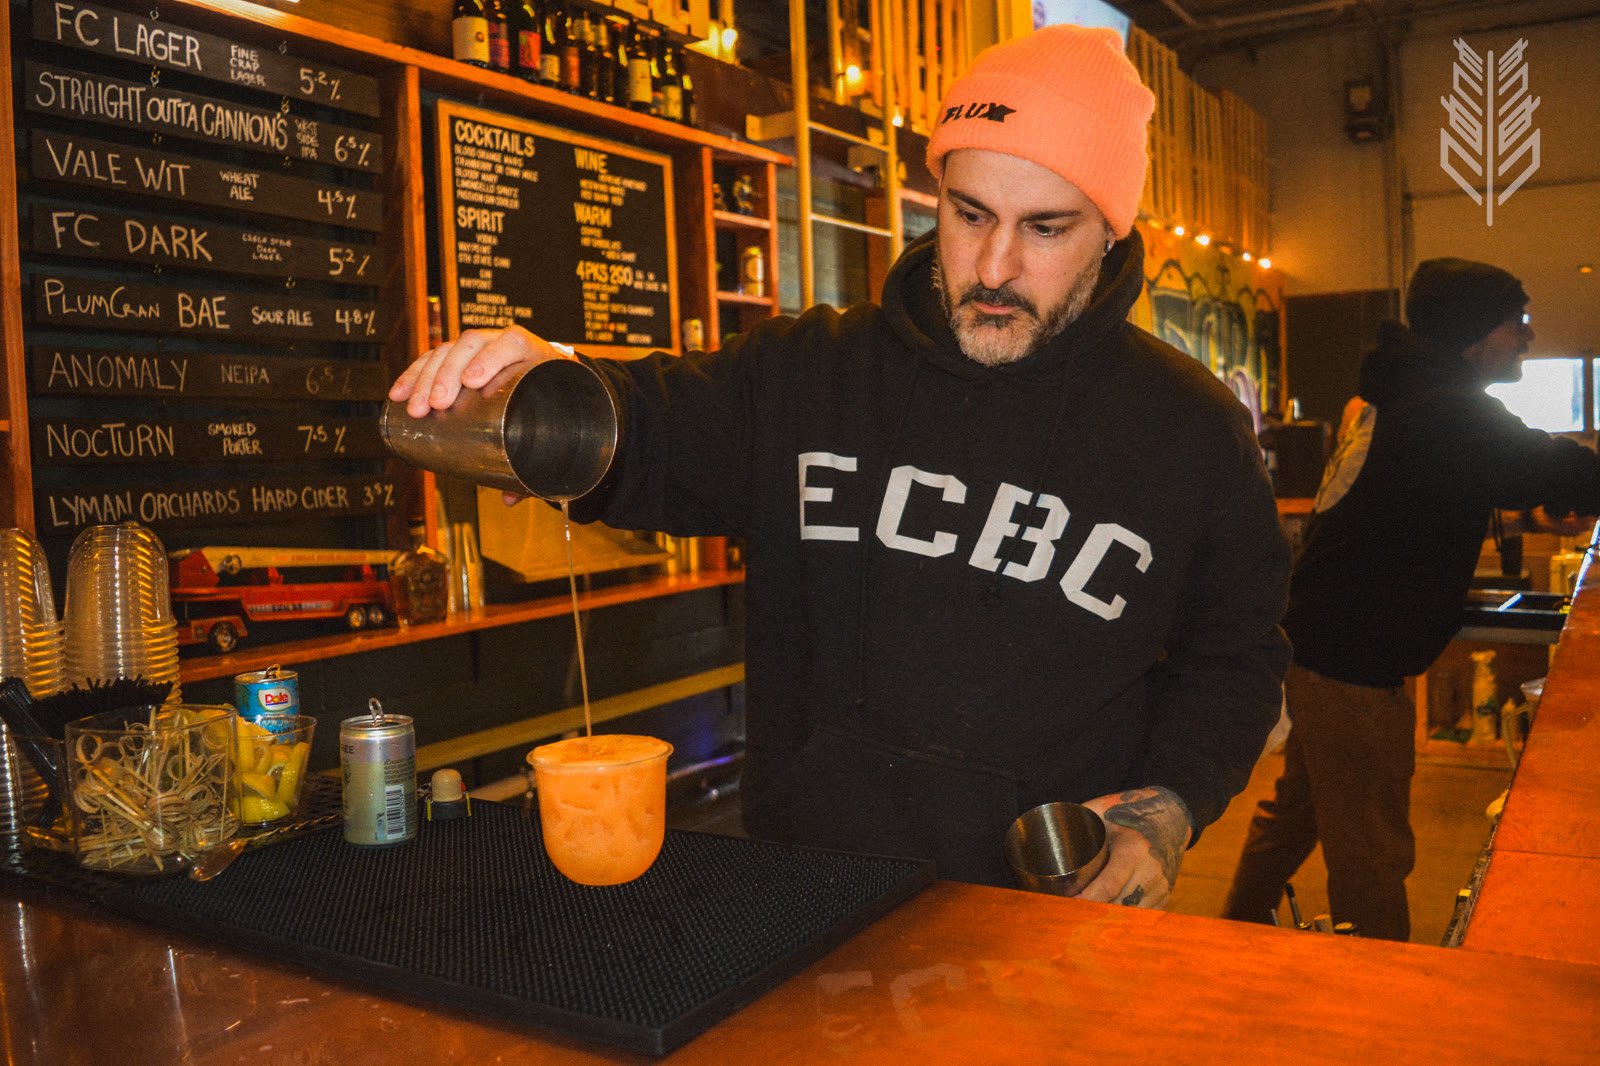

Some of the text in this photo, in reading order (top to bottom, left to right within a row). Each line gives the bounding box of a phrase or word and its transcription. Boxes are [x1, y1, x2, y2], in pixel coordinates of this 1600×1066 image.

[55, 2, 202, 71] FC LAGER
[231, 45, 259, 61] FINE
[231, 70, 266, 87] LAGER
[35, 71, 288, 150] STRAIGHT OUTTA CANNON'S
[455, 120, 536, 157] COCKTAILS
[302, 147, 318, 160] IPA
[575, 148, 608, 174] WINE
[46, 139, 190, 196] VALE WIT
[220, 171, 260, 188] WHEAT
[230, 186, 254, 200] ALE
[457, 206, 505, 233] SPIRIT
[574, 201, 612, 228] WARM
[51, 212, 212, 262] FC DARK
[178, 293, 231, 329] BAE
[252, 305, 285, 326] SOUR
[286, 310, 313, 328] ALE
[48, 352, 270, 392] ANOMALY NEIPA
[47, 422, 174, 457] NOCTURN
[208, 422, 256, 436] SMOKED
[223, 437, 262, 455] PORTER
[50, 491, 131, 527] LYMAN
[140, 488, 240, 523] ORCHARDS
[252, 486, 297, 512] HARD
[301, 486, 348, 510] CIDER
[264, 692, 288, 704] Dole
